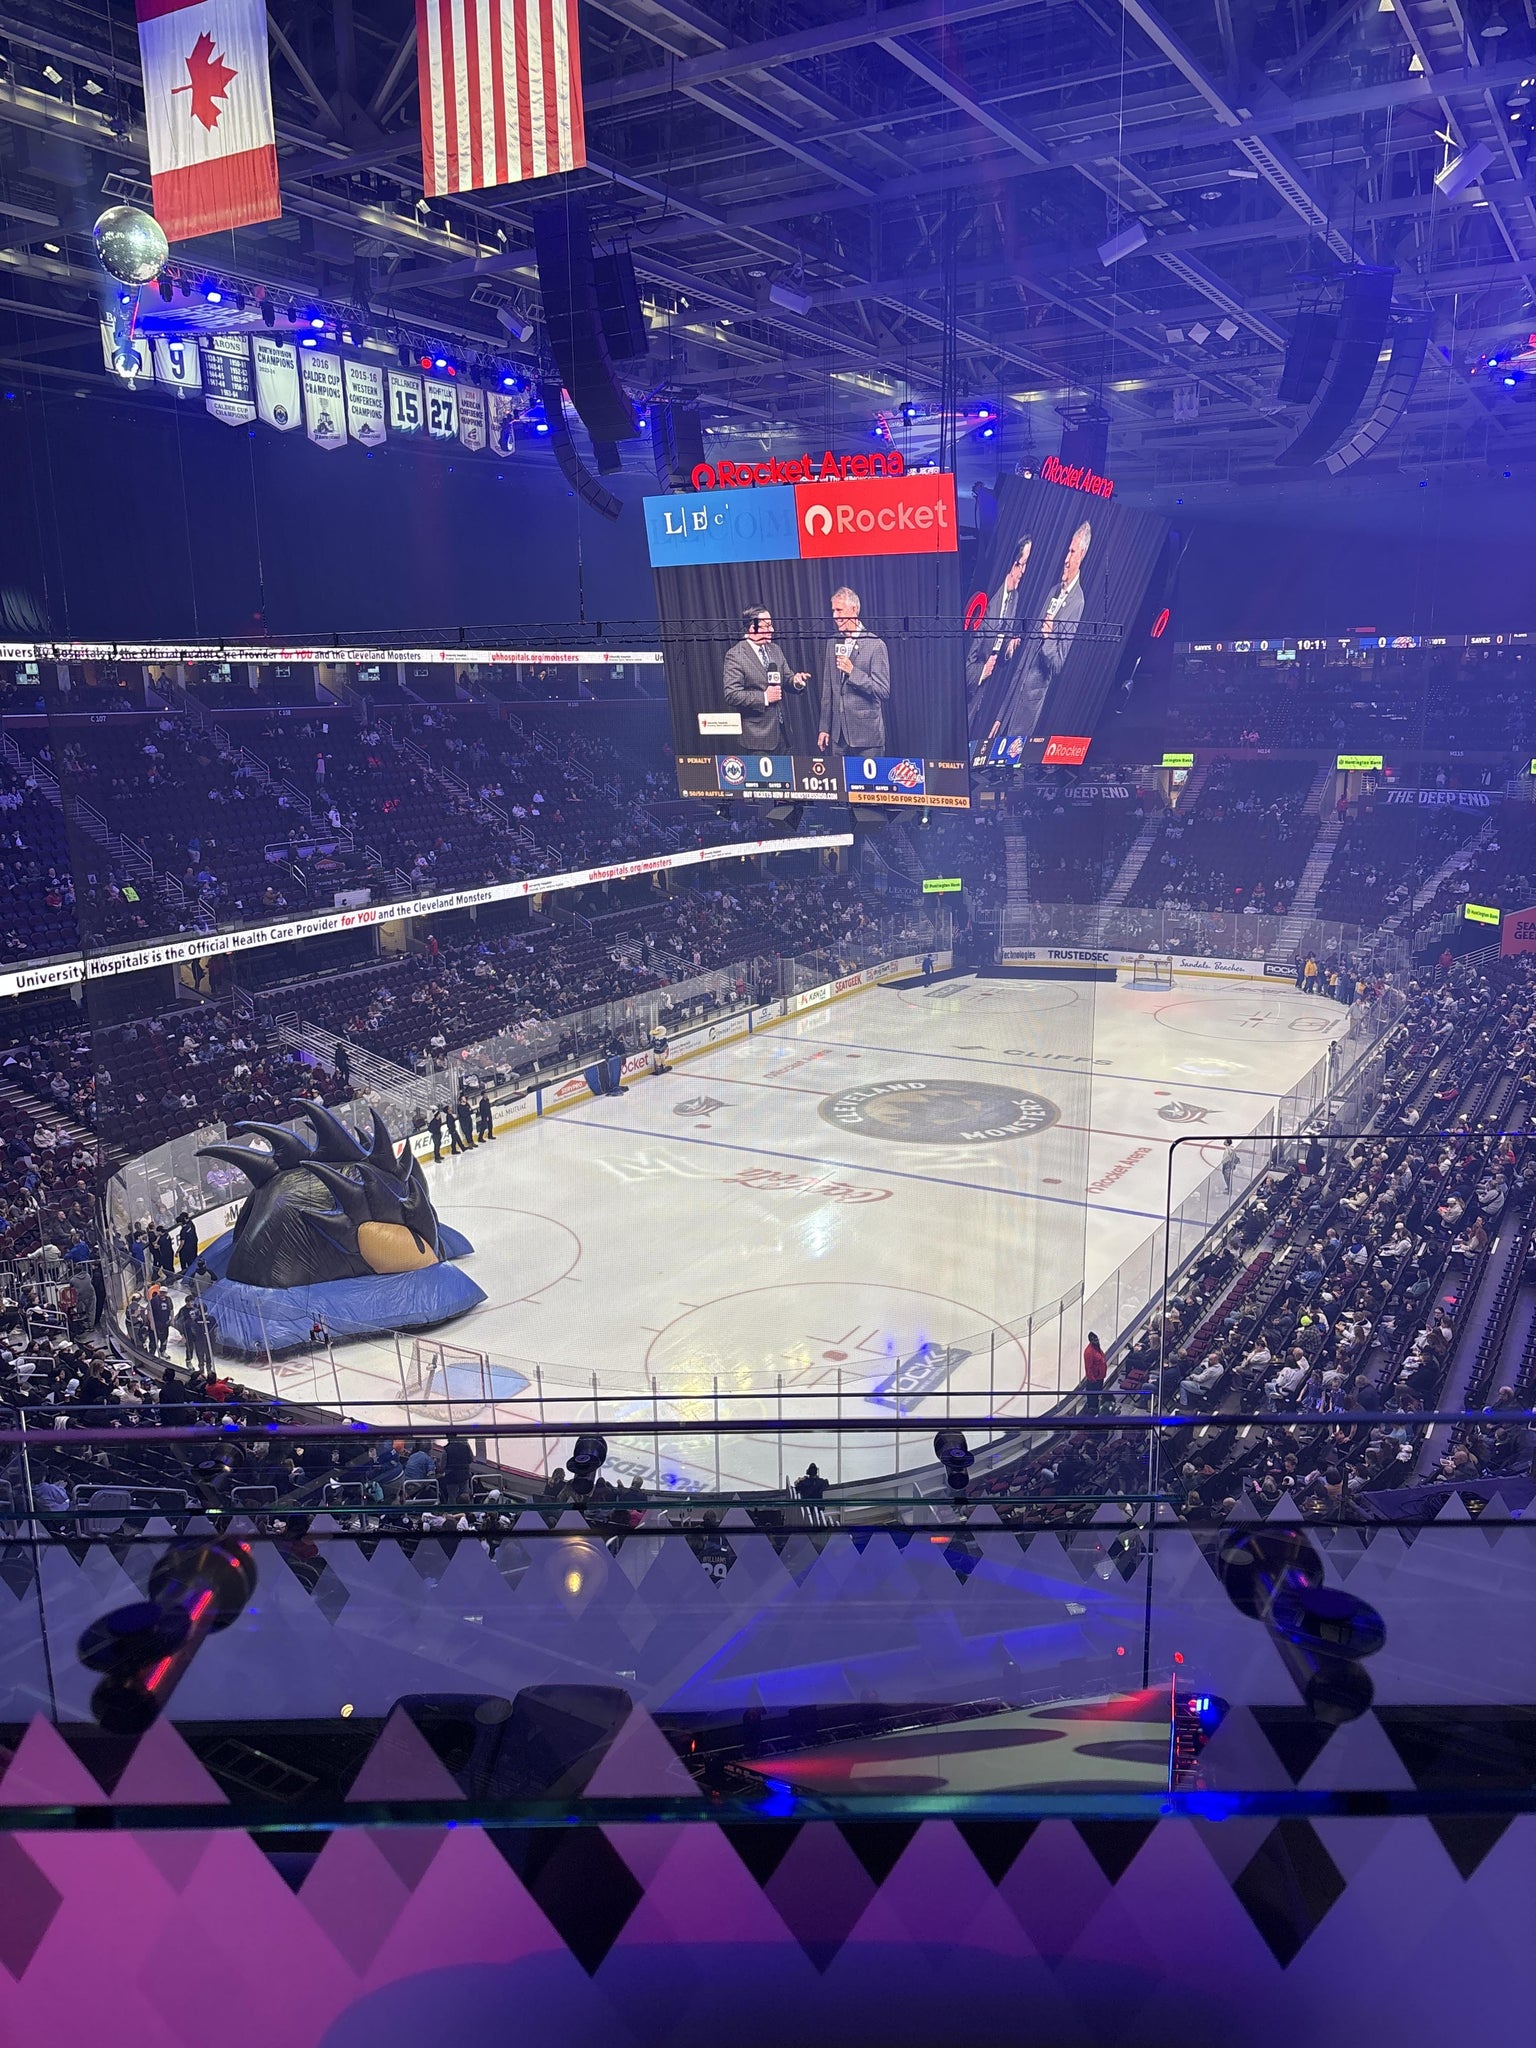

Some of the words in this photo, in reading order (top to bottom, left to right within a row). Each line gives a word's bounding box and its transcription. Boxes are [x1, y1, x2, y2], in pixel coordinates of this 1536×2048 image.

[257, 353, 295, 369] CHAMPIONS
[312, 357, 329, 370] 2016
[303, 370, 326, 384] CALDER
[327, 374, 340, 386] CUP
[350, 368, 378, 383] 2015-16
[305, 382, 341, 399] CHAMPIONS
[352, 382, 378, 396] WESTERN
[350, 394, 383, 409] CONFERENCE
[396, 390, 419, 424] 15
[351, 405, 383, 420] CHAMPIONS
[431, 398, 453, 432] 27
[717, 453, 812, 488] Rocket
[820, 450, 905, 478] Arena
[1048, 456, 1085, 490] Rocket
[1079, 468, 1114, 499] Arena
[836, 499, 949, 534] Rocket
[1216, 643, 1223, 651] 0
[1260, 640, 1269, 651] 0
[1378, 637, 1387, 648] 0
[1496, 635, 1503, 644] 0
[239, 649, 278, 660] Provider
[280, 649, 293, 660] for
[296, 650, 313, 660] YOU
[315, 650, 330, 660] and
[332, 650, 345, 660] the
[348, 650, 386, 661] Cleveland
[387, 651, 422, 661] Monsters
[491, 652, 580, 664] uhhospitals.org/monsters
[997, 738, 1007, 755] 0
[1055, 744, 1088, 758] Rocket
[759, 756, 773, 777] 0
[863, 758, 877, 780] 0
[802, 777, 838, 791] 10:11
[1065, 786, 1099, 799] DEEP
[1102, 786, 1130, 799] END
[1386, 790, 1416, 804] THE
[1418, 791, 1456, 805] DEEP
[1458, 793, 1490, 807] END
[16, 965, 86, 989] University
[90, 951, 149, 976] Hospitals
[152, 949, 162, 963] is
[165, 947, 185, 960] the
[188, 937, 229, 955] Official
[233, 930, 268, 947] Health
[270, 926, 294, 940] Care
[296, 918, 338, 938] Provider
[341, 915, 356, 927] for
[358, 910, 377, 923] YOU
[378, 907, 395, 920] and
[397, 905, 412, 917] the
[413, 896, 454, 913] Cleveland
[456, 890, 492, 906] Monsters
[588, 858, 673, 881] uhhospitals.org/monsters
[1516, 921, 1536, 931] SEA
[1514, 931, 1536, 940] GEE
[1047, 949, 1110, 963] TRUSTEDSEC
[834, 973, 863, 994] SEATGEEK
[808, 988, 827, 1001] KENDA
[621, 1053, 649, 1076] ocket
[1002, 1049, 1114, 1066] CLIFFS
[561, 1081, 584, 1094] SERVPRO
[505, 1102, 528, 1116] MUTUAL
[834, 1081, 927, 1124] CLEVELAND
[960, 1099, 1046, 1141] MONSTERS
[1090, 1164, 1132, 1189] Rocket
[1118, 1147, 1153, 1167] Arena
